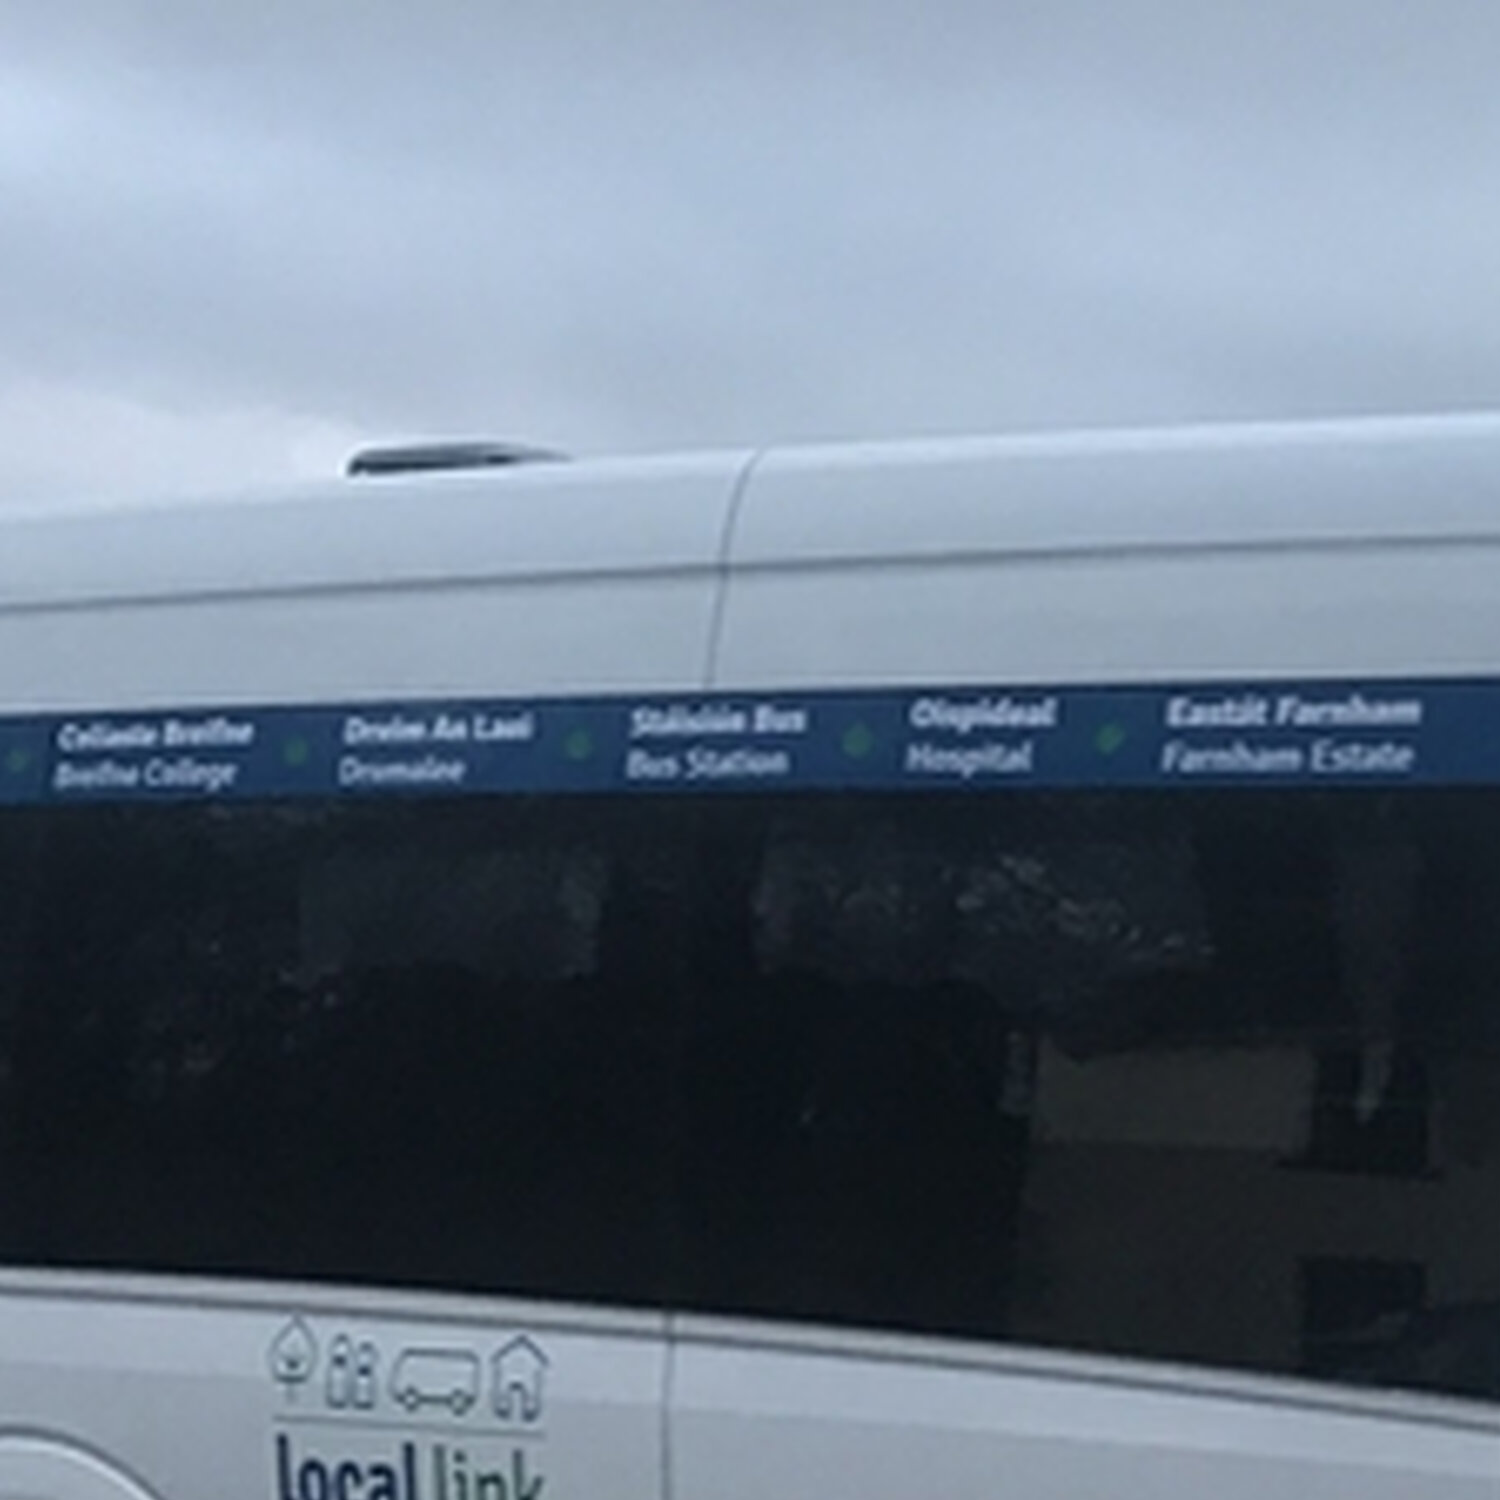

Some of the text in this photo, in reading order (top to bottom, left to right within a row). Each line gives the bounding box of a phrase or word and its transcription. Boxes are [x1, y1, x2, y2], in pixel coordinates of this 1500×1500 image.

[754, 704, 806, 733] Bus
[1274, 693, 1422, 726] Farnham
[627, 745, 790, 779] Bus Station
[905, 741, 1033, 780] Hospital
[1162, 738, 1415, 773] Farnham Estate
[143, 756, 237, 791] College
